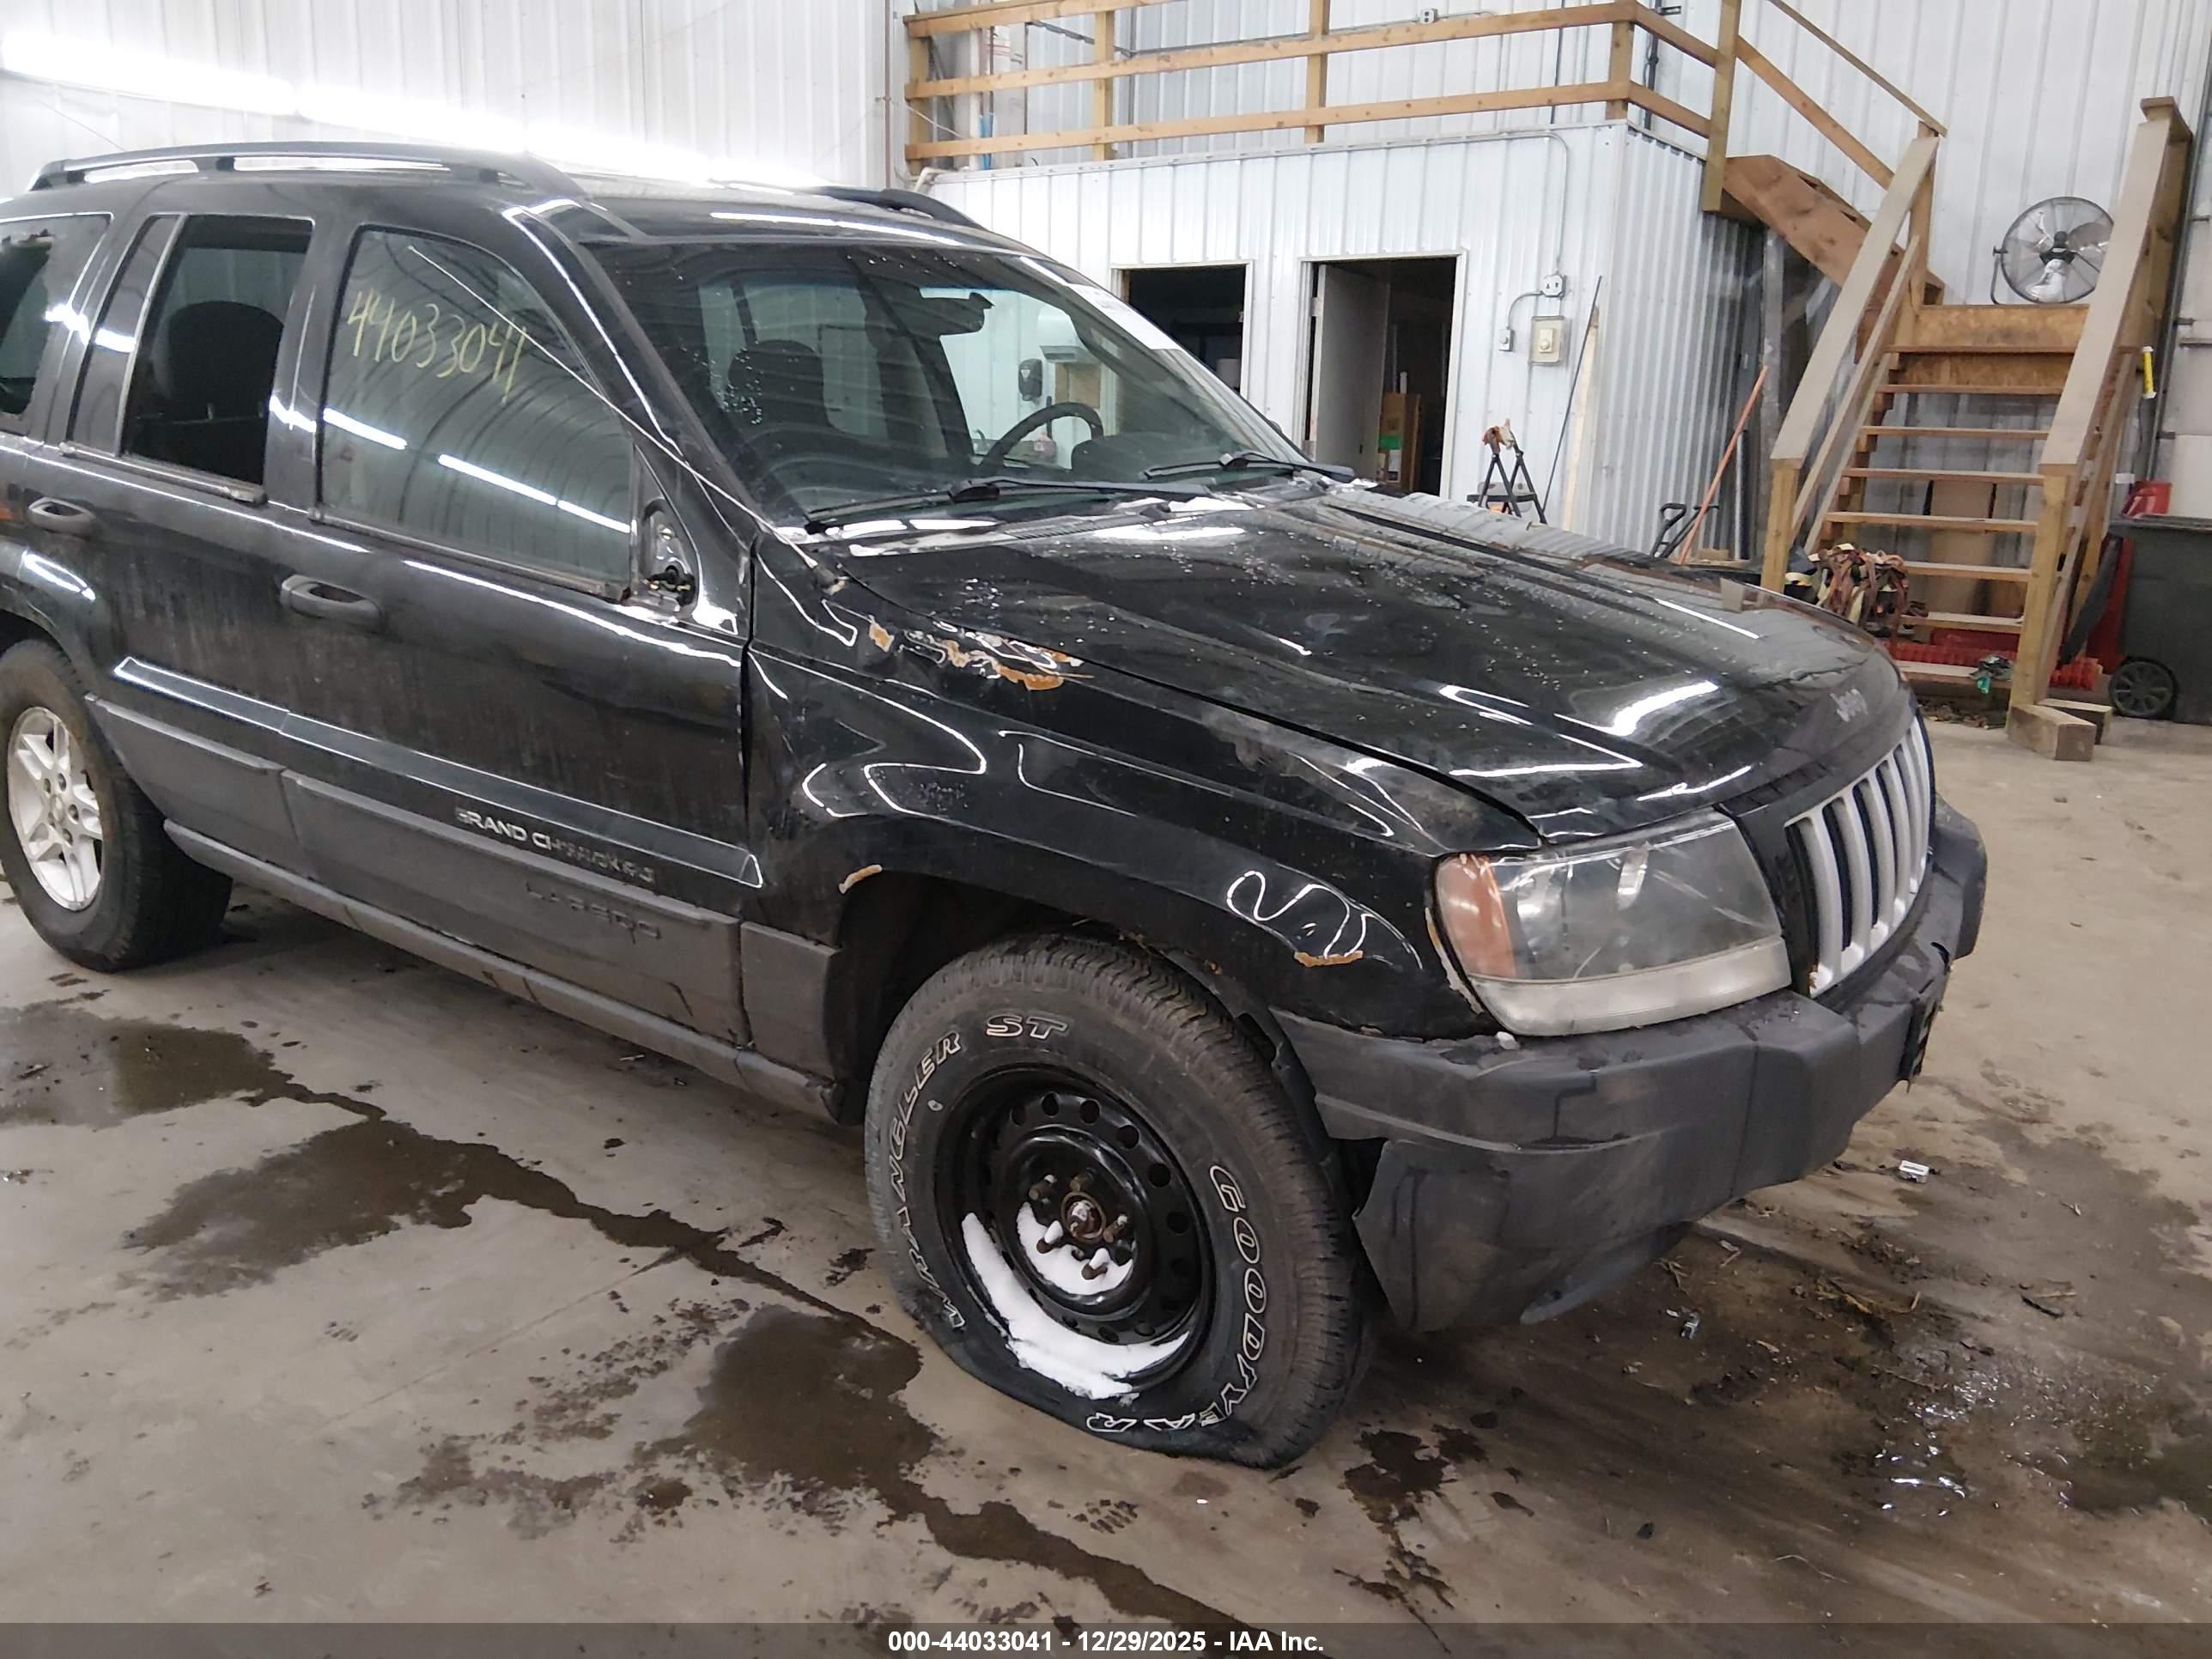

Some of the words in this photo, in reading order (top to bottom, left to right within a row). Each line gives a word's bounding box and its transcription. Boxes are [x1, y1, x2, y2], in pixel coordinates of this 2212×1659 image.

[347, 288, 527, 404] 44033041
[986, 1013, 1070, 1040] ST
[1086, 1165, 1267, 1432] GOODYEAR
